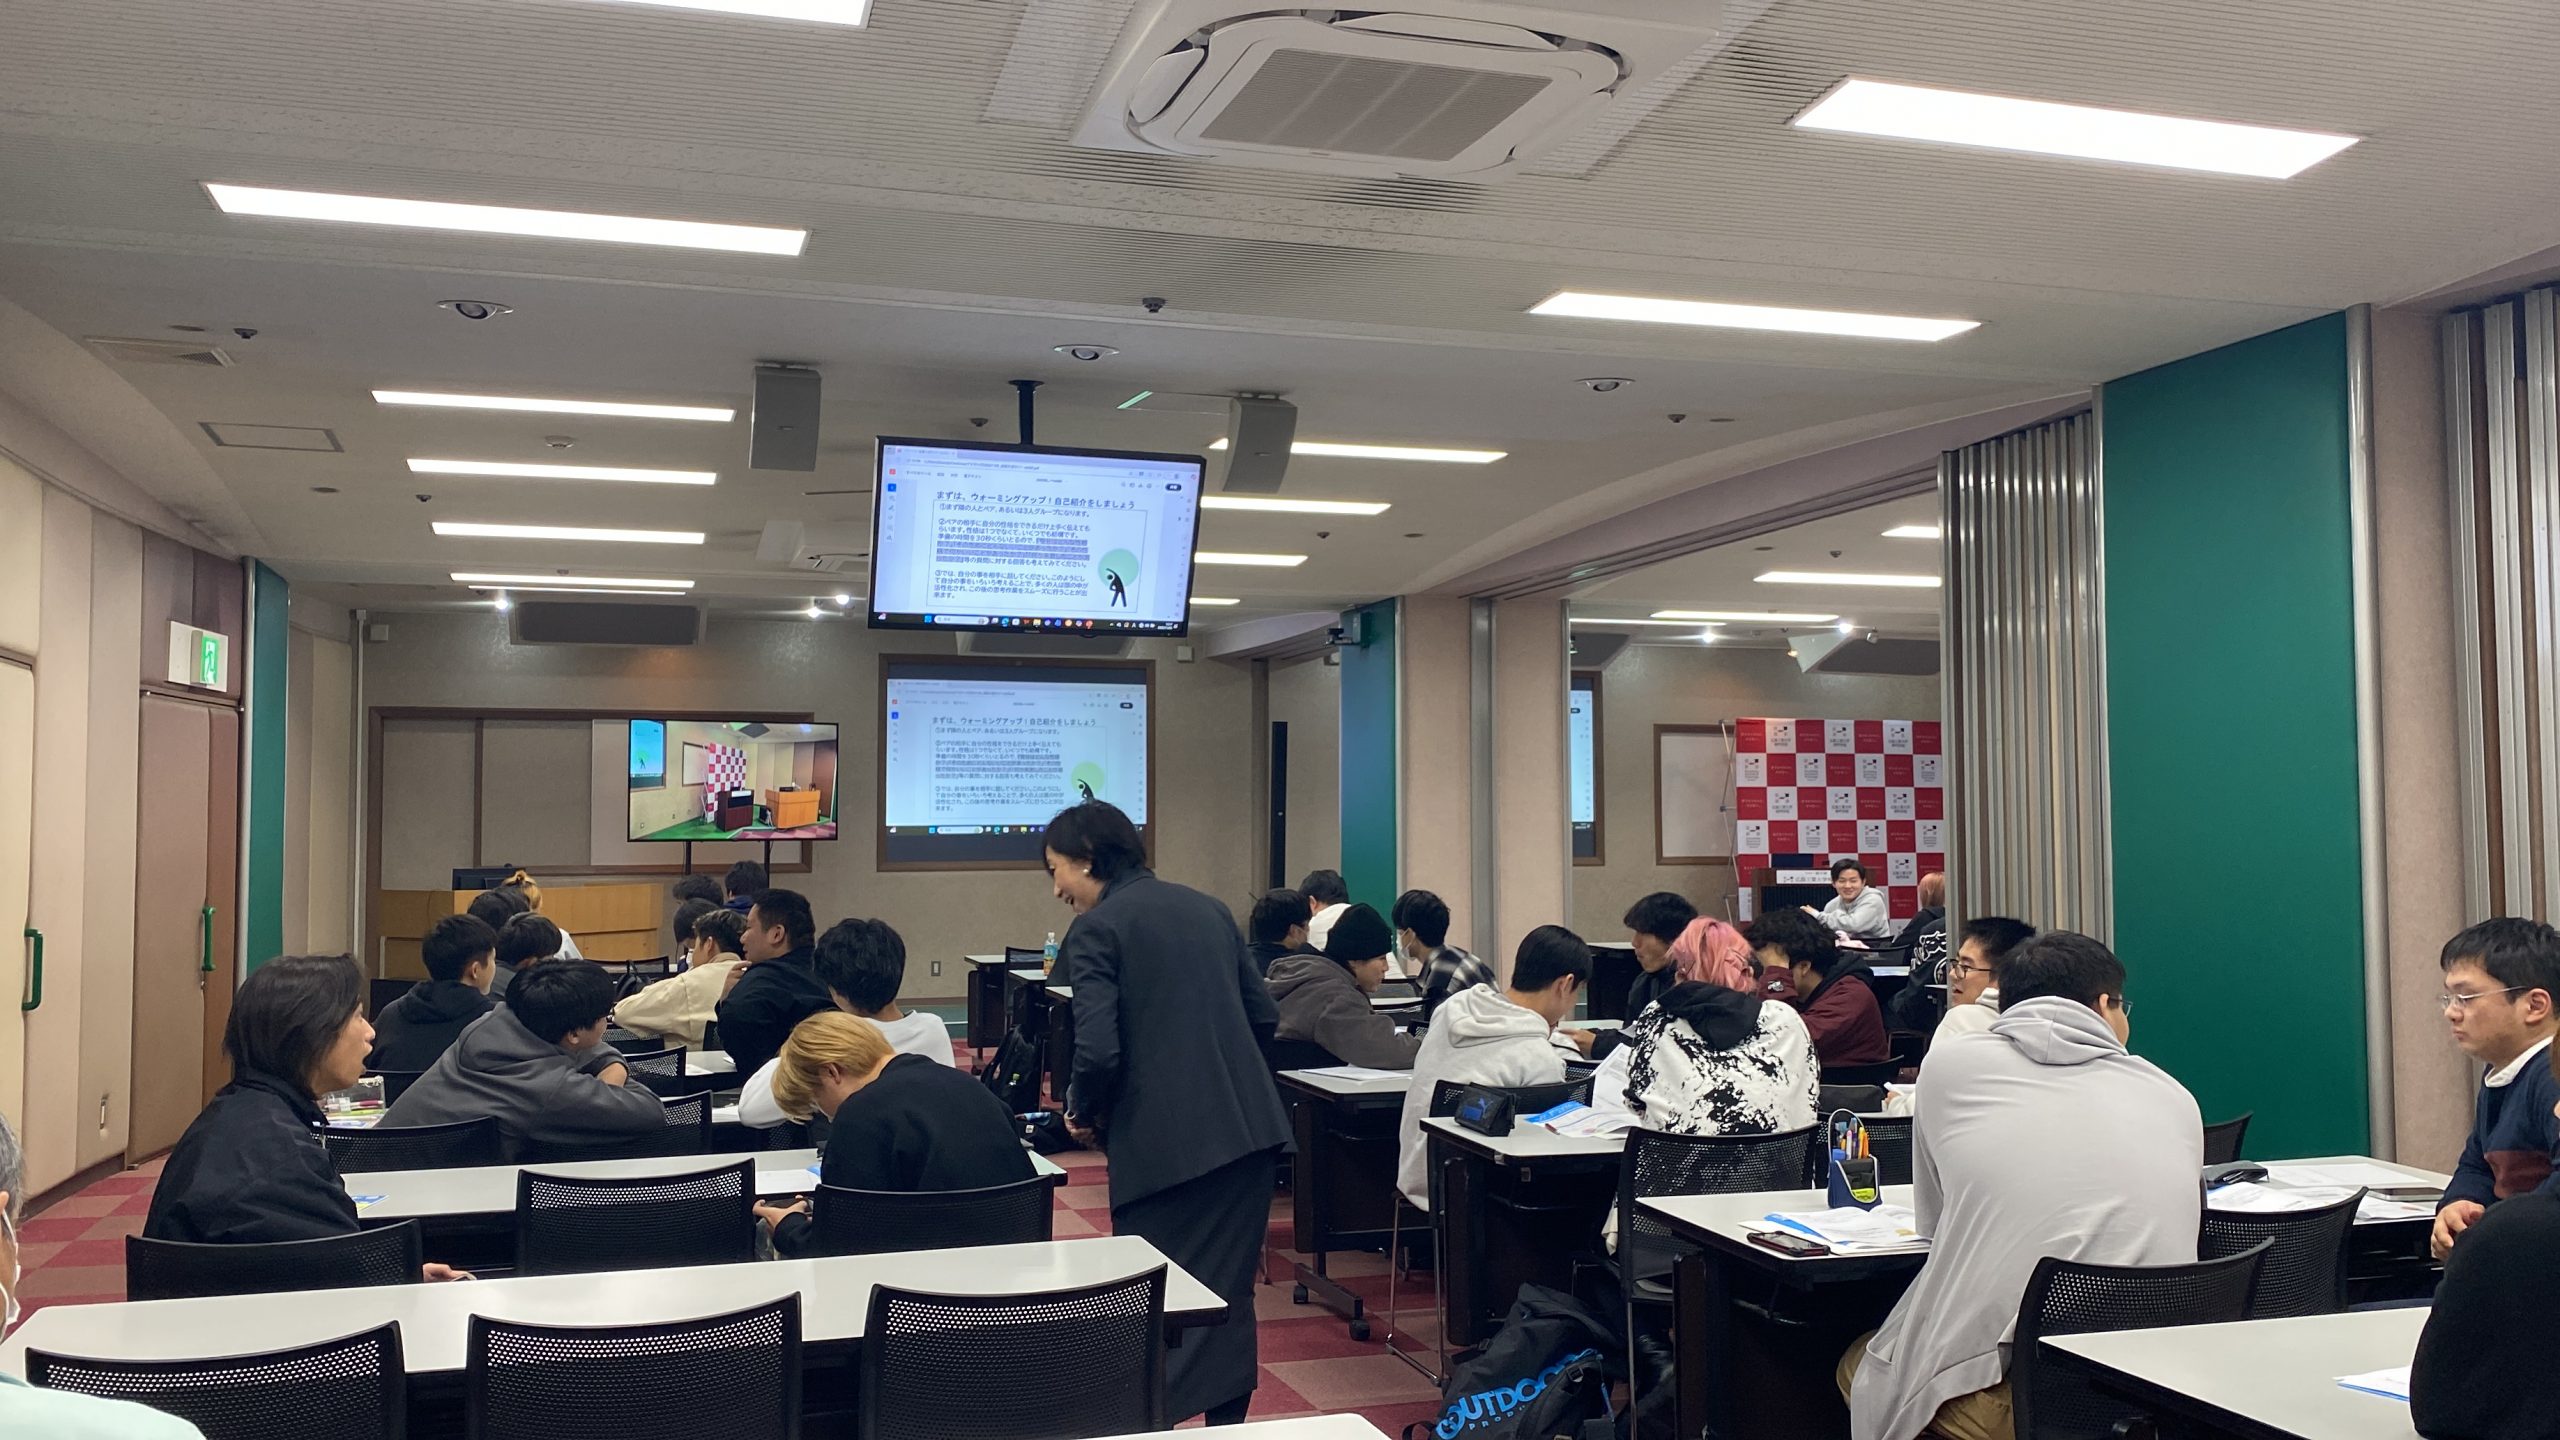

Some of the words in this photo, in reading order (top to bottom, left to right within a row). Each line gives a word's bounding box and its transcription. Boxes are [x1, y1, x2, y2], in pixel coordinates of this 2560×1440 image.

[937, 491, 1135, 509] まずは、ウォーミングアップ！自己紹介をしましょう
[1469, 1405, 1526, 1430] PROD
